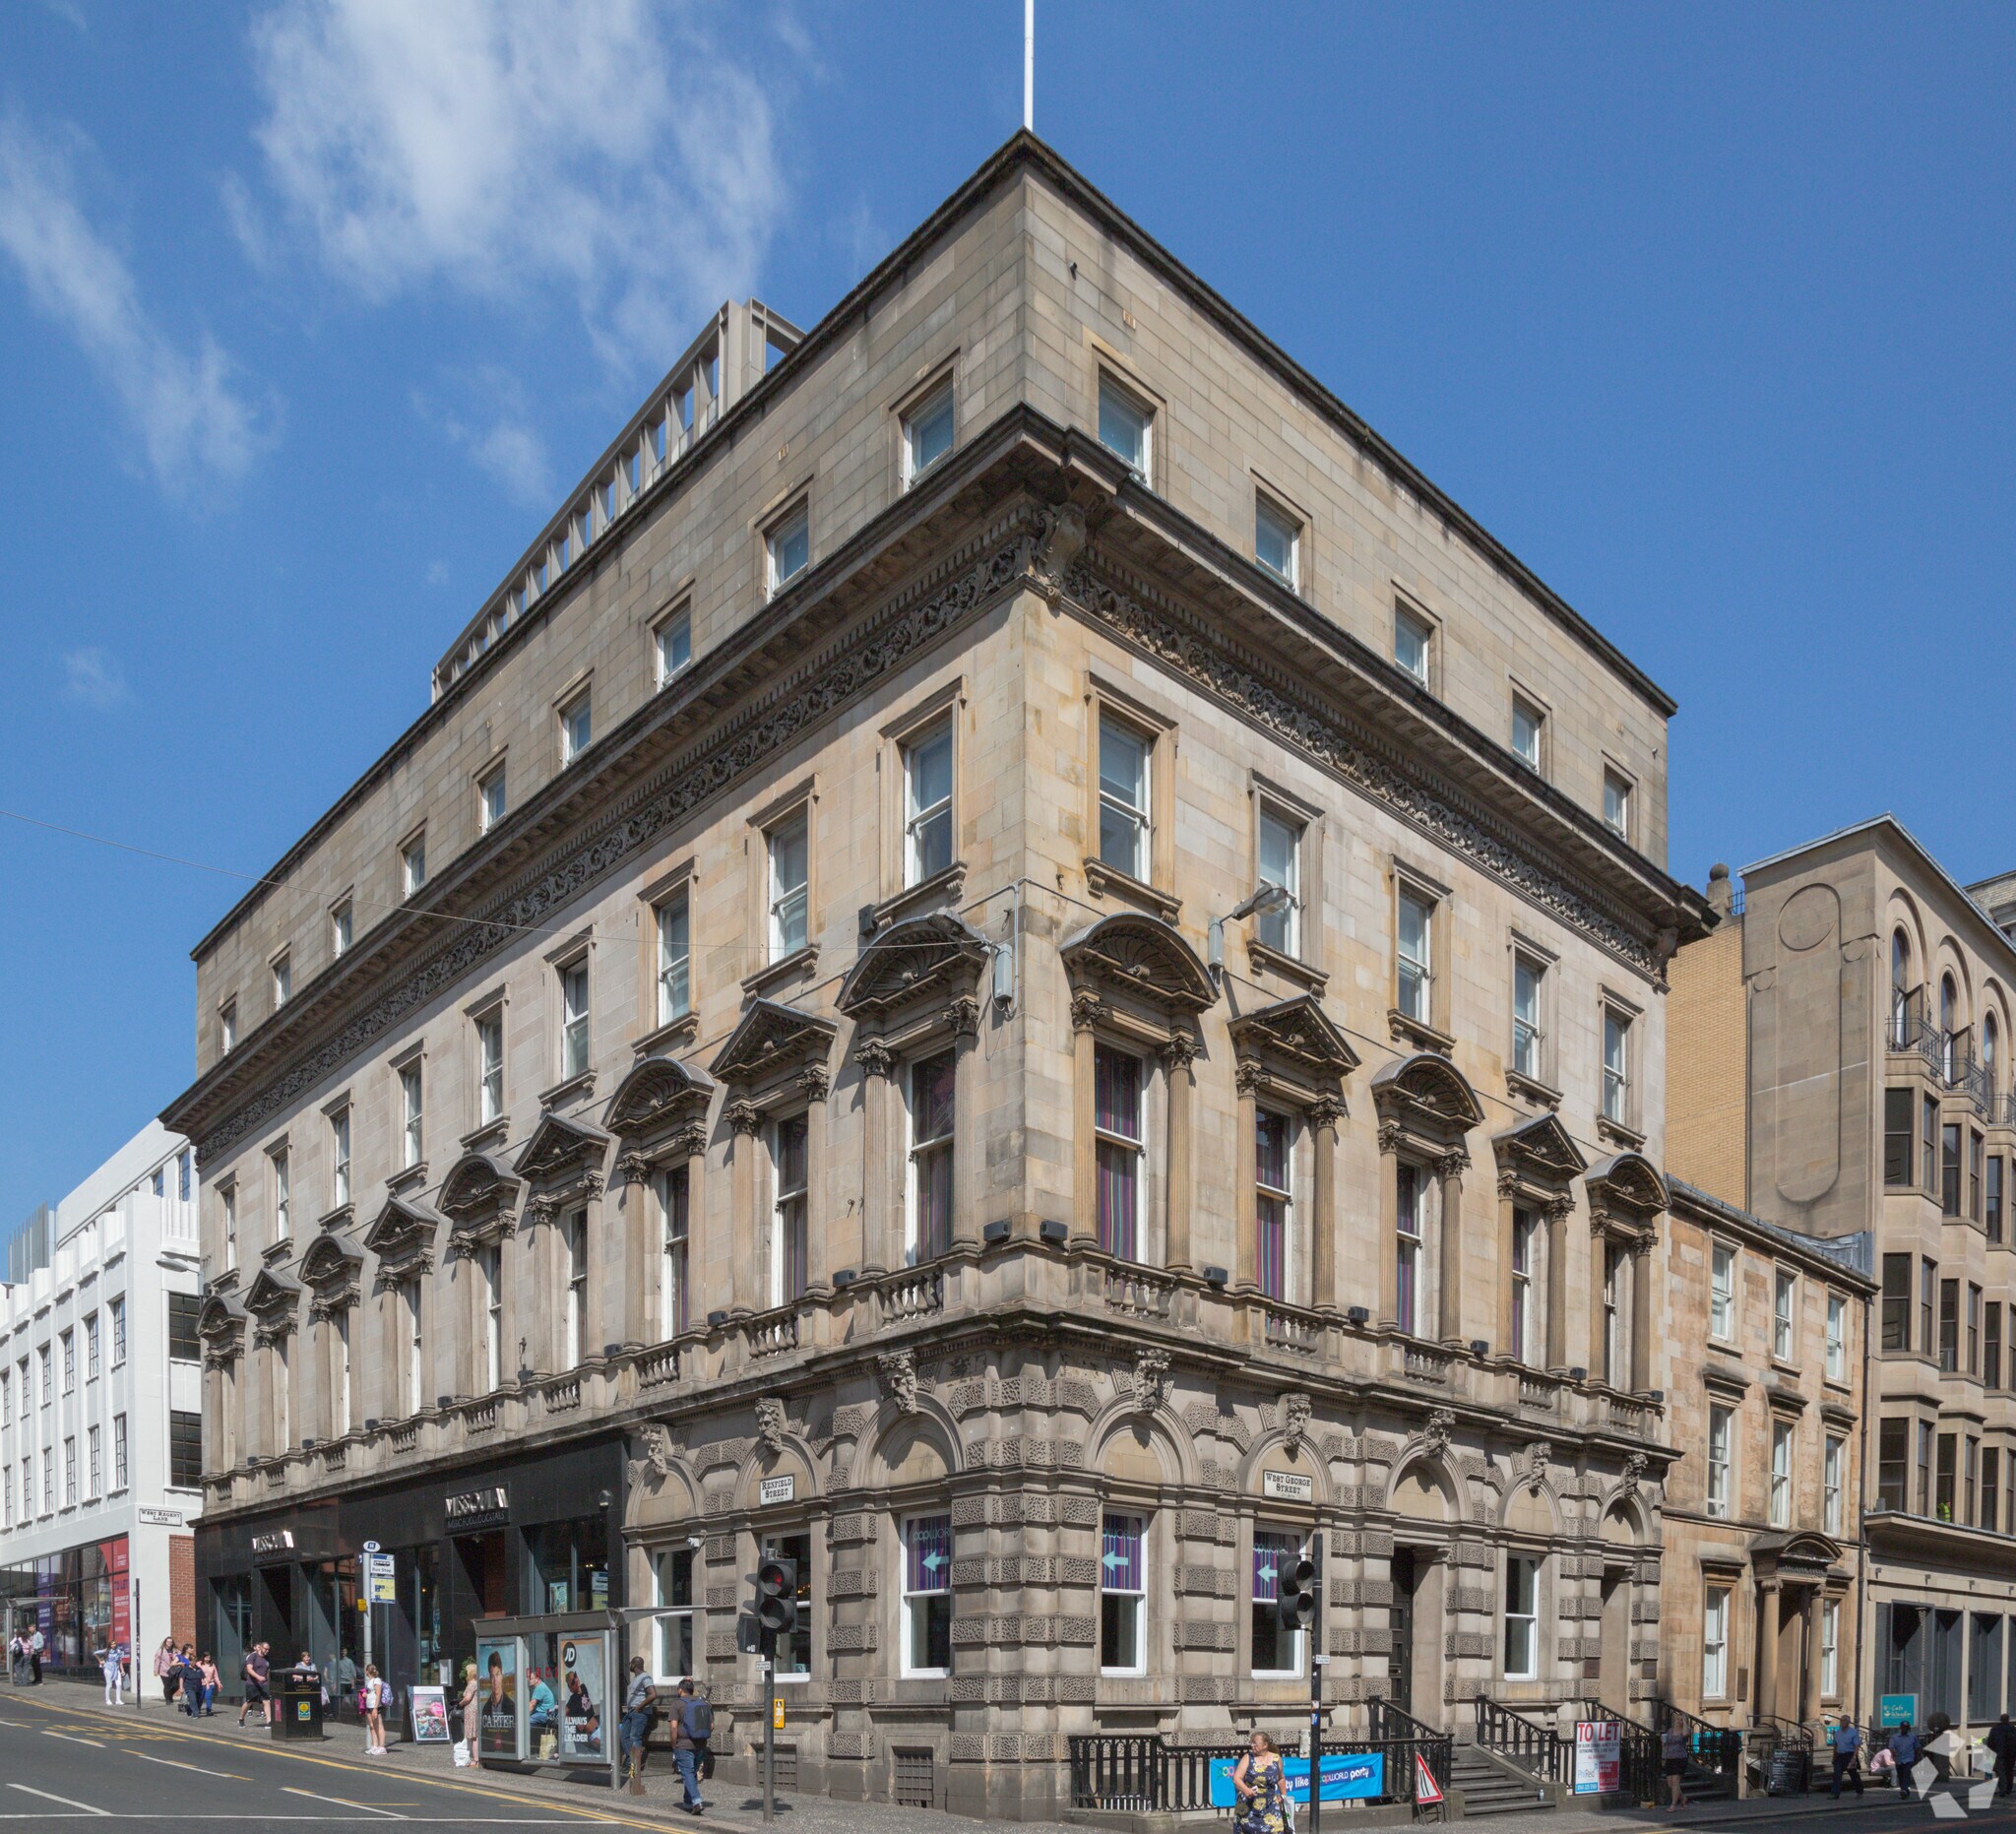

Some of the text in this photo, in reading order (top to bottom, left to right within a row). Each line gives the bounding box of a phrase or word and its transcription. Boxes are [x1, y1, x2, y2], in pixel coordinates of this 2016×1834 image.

[762, 1479, 791, 1490] RENFIELD
[1266, 1472, 1310, 1486] WEST GEORGE
[765, 1488, 788, 1498] STREET
[1276, 1483, 1300, 1493] STREET
[564, 1647, 575, 1662] JD
[482, 1715, 515, 1728] CARTER
[564, 1717, 588, 1726] ALWAYS
[564, 1734, 589, 1742] LEADER
[1578, 1723, 1619, 1741] TO LET
[1294, 1777, 1309, 1788] like
[1350, 1766, 1369, 1781] party
